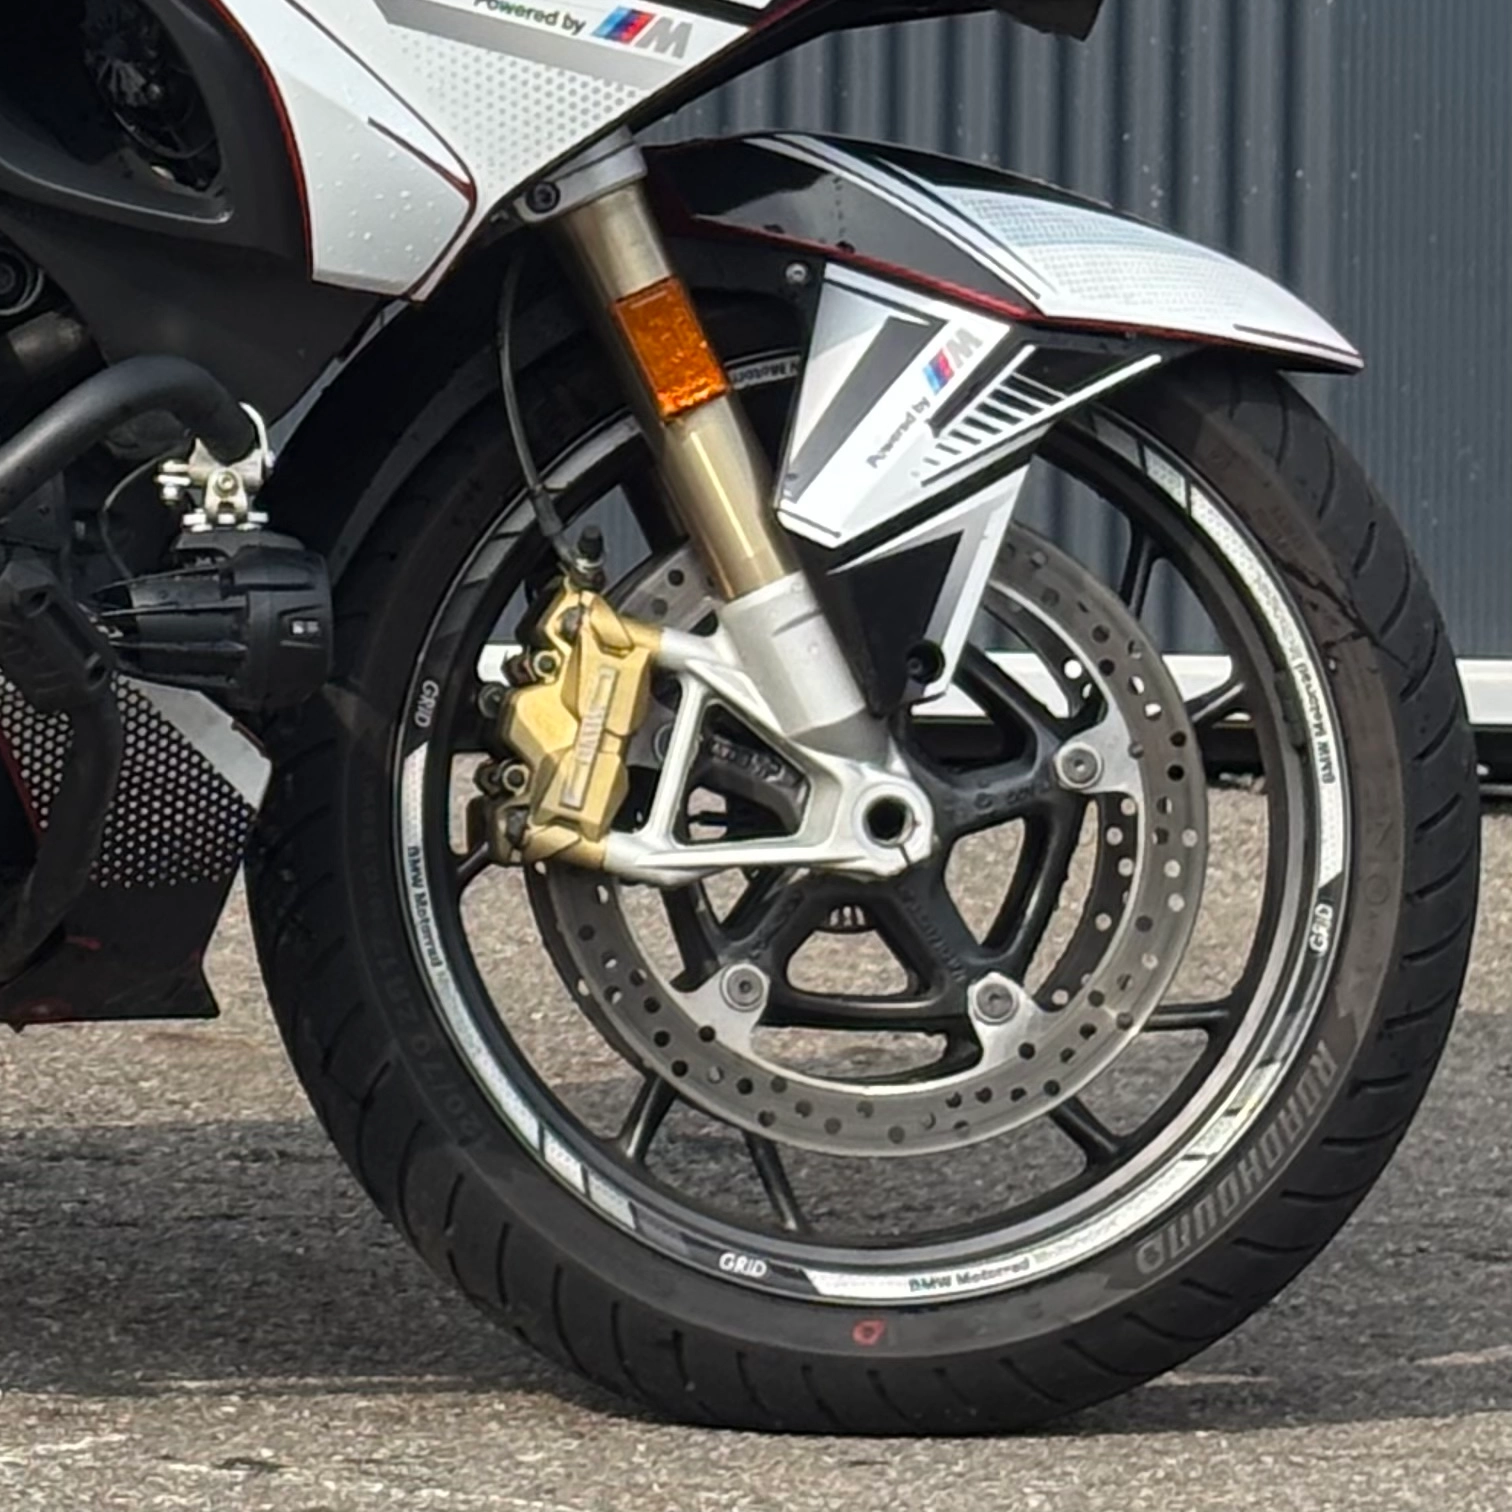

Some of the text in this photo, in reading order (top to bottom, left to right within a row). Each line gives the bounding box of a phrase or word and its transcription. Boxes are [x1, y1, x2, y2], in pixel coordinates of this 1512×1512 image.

[561, 12, 587, 37] by
[910, 395, 931, 415] by
[414, 679, 439, 728] GRID
[1294, 661, 1337, 785] BMW Motorrad
[407, 845, 443, 969] BMW Motorrad
[1309, 903, 1334, 957] GRID
[1136, 1039, 1338, 1275] ROADHOUND
[718, 1252, 767, 1279] GRID
[908, 1257, 1030, 1293] BMW Motorrad
